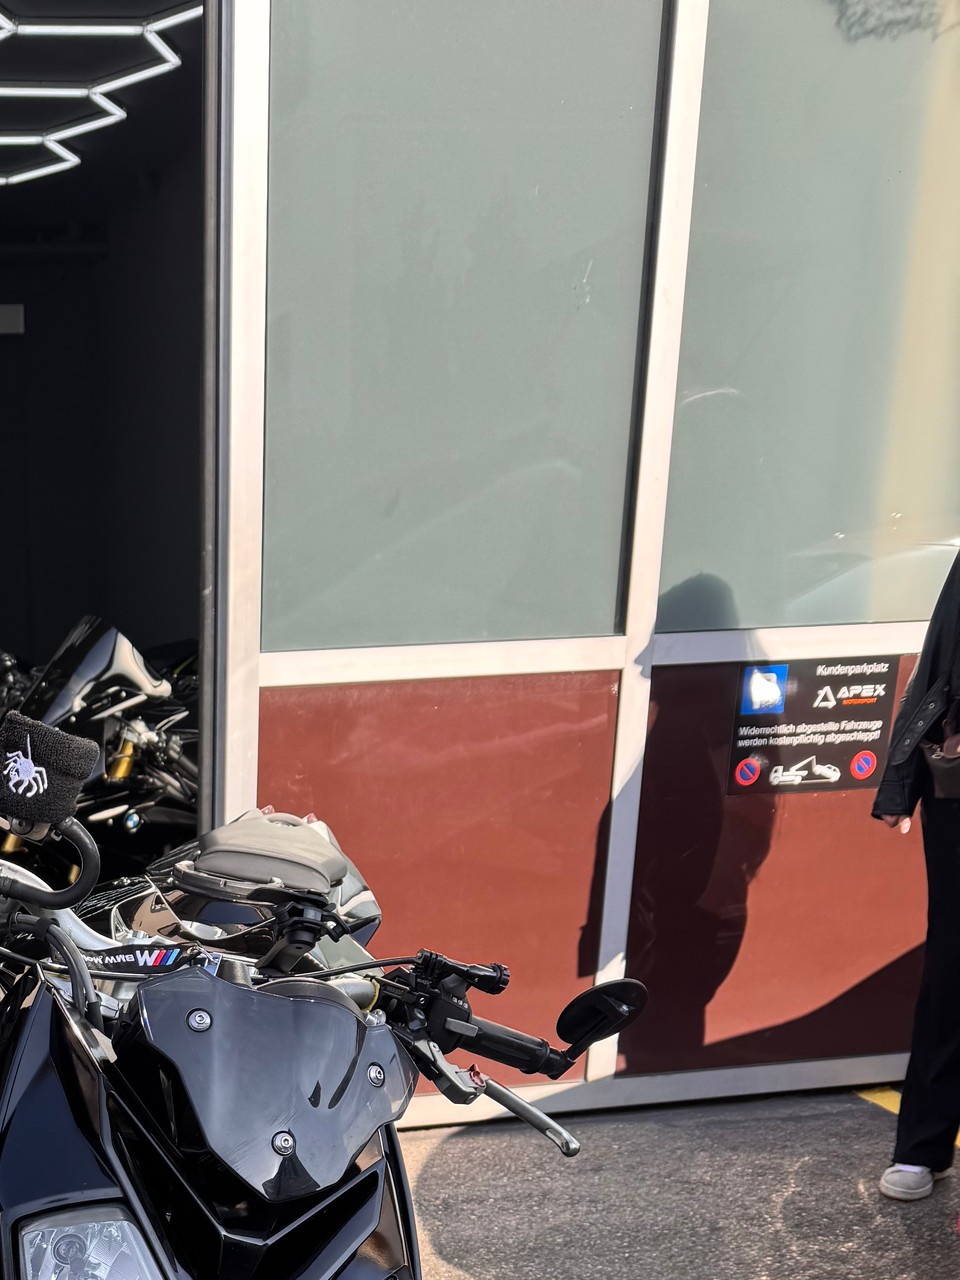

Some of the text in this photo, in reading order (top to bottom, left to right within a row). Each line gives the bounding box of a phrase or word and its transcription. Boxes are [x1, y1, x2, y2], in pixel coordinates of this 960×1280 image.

[816, 662, 890, 676] Kundenparkplatz
[836, 683, 887, 699] APEX
[842, 697, 878, 706] MOTORSPORT
[739, 719, 883, 736] Widerrechtlich abgestellte Fahrzeuge
[737, 730, 881, 747] werden kostenpflichtig abgeschleppt!
[104, 953, 136, 964] BMW
